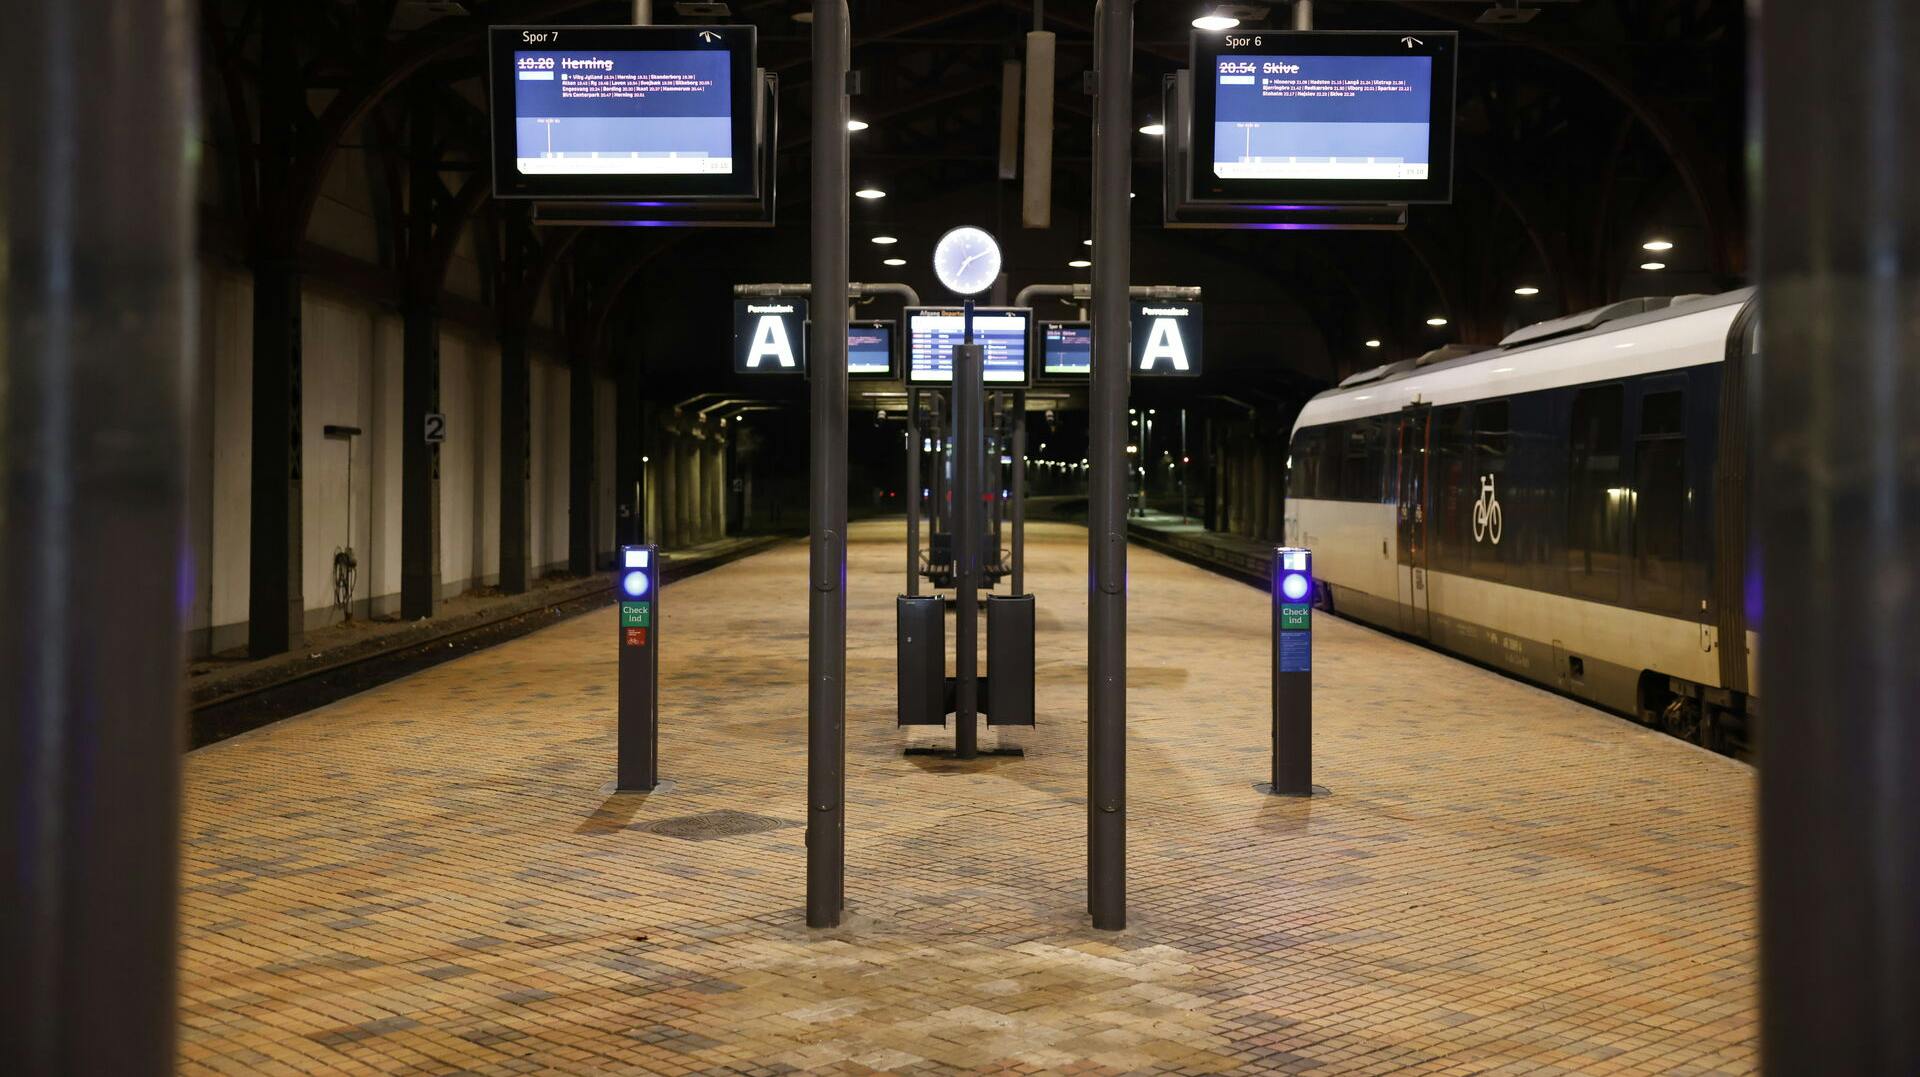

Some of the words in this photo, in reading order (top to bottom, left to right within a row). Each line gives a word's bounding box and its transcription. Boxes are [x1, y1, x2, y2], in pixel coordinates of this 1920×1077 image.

[522, 30, 548, 45] Spor
[551, 31, 559, 42] 7
[1225, 35, 1251, 49] Spor
[1254, 36, 1262, 47] 6
[561, 56, 614, 71] Herning
[1219, 62, 1257, 74] 20.54
[1263, 61, 1300, 74] Skive
[746, 315, 796, 368] A
[1139, 318, 1190, 370] A
[428, 416, 442, 438] 2
[623, 606, 649, 614] Check
[1283, 607, 1309, 616] Check
